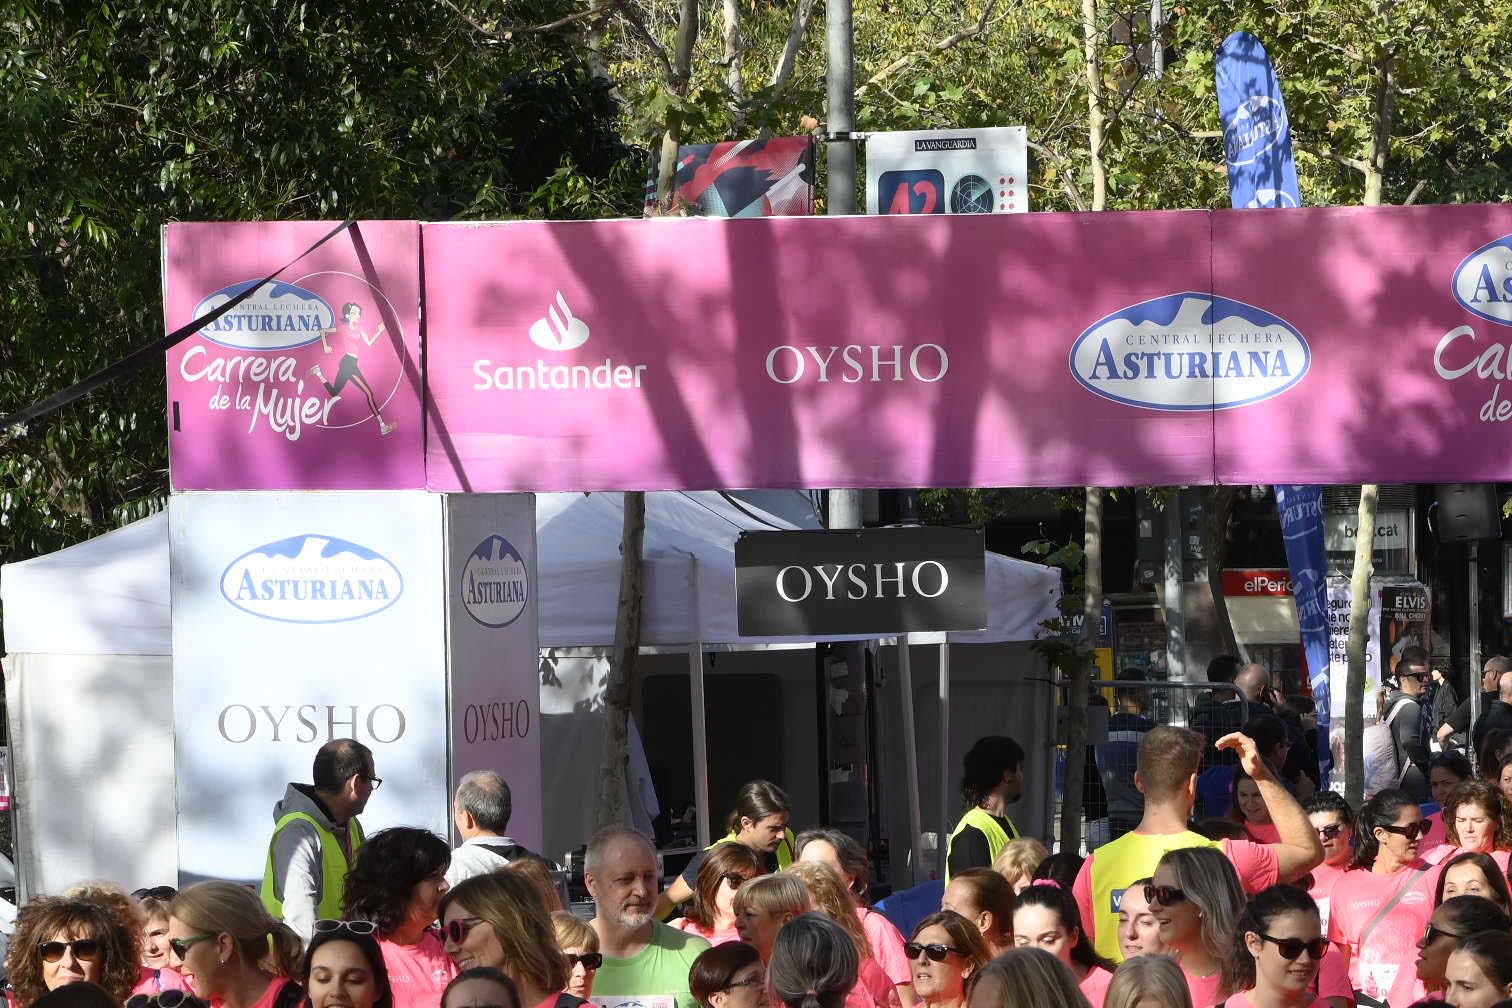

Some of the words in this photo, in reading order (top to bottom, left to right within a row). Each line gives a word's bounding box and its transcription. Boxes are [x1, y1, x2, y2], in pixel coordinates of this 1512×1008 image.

[1125, 333, 1202, 346] CENTRAL
[1209, 331, 1284, 345] LECHERA
[179, 344, 297, 383] Carrera
[473, 358, 646, 391] Santander
[765, 343, 950, 384] OYSHO
[1089, 336, 1291, 381] ASTURIANA
[209, 383, 230, 410] de
[235, 382, 251, 410] la
[248, 379, 342, 441] Mujer
[235, 568, 392, 601] ASTURIANA
[466, 573, 525, 604] ASTURIANA
[776, 560, 949, 603] OYSHO
[1395, 596, 1425, 609] ELVIS
[218, 704, 406, 743] OYSHO
[464, 700, 529, 744] OYSHO
